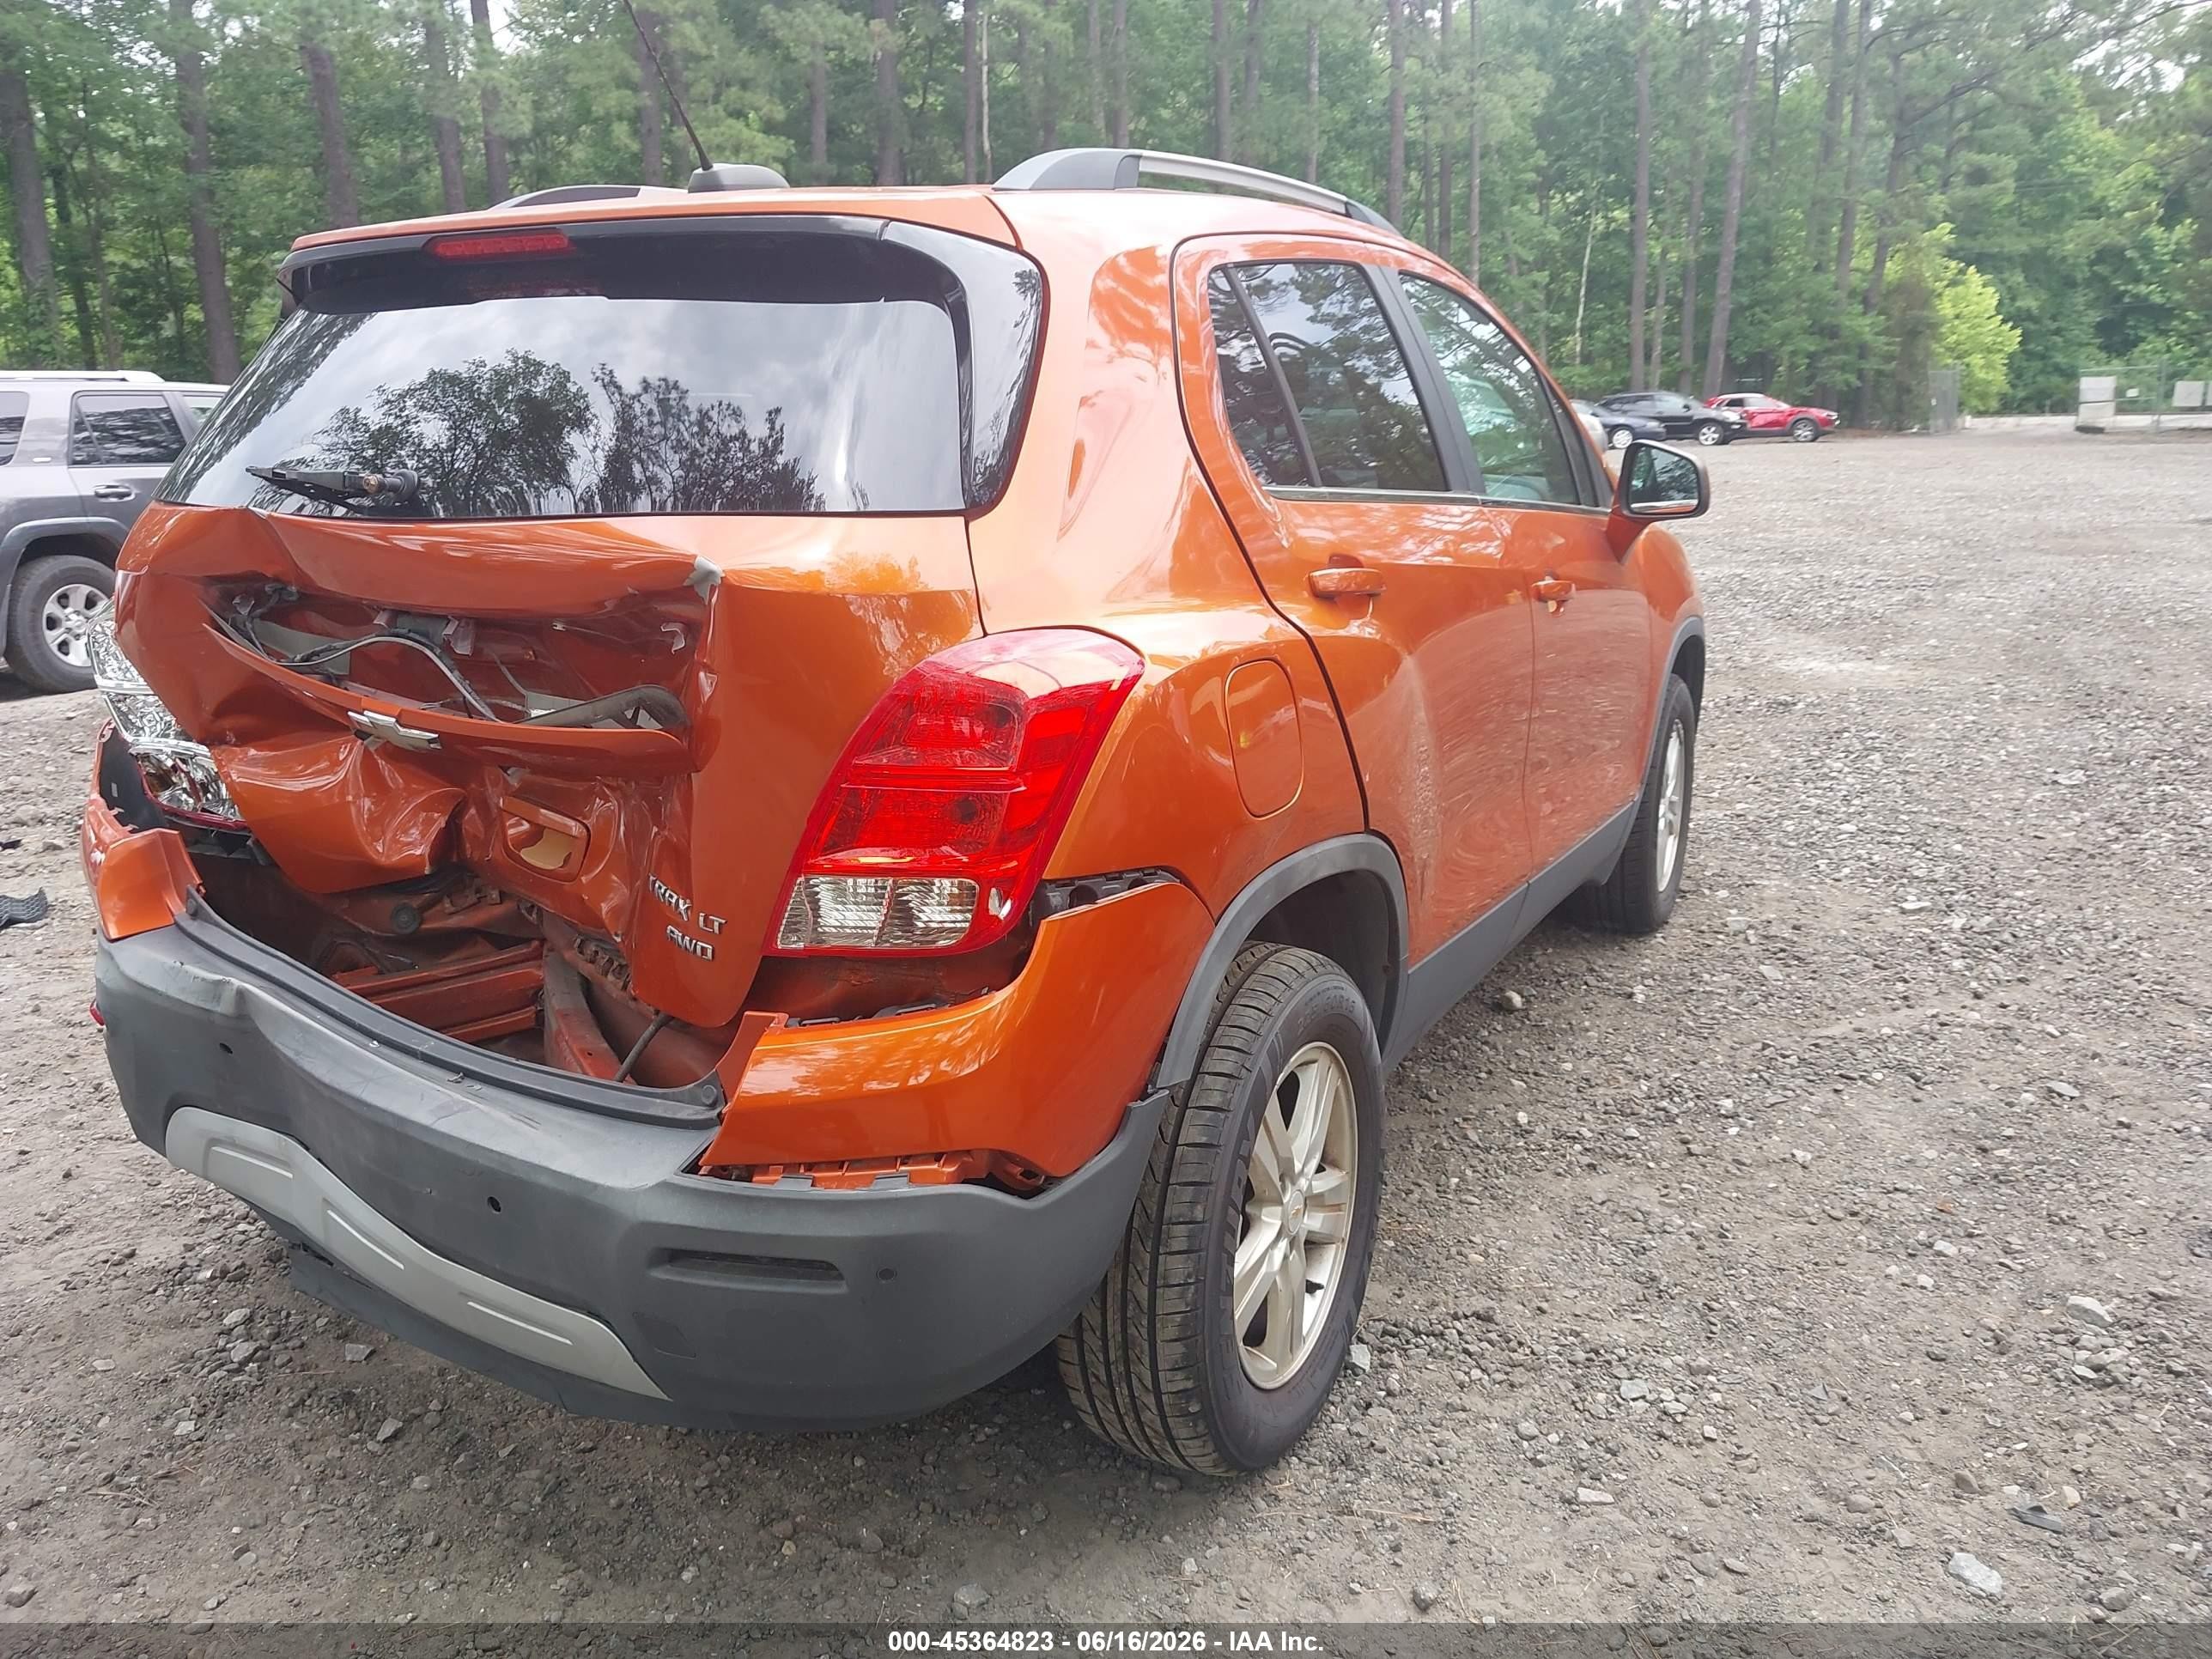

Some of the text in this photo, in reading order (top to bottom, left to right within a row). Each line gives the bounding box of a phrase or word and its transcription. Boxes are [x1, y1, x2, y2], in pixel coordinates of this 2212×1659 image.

[648, 872, 728, 935] TRAX LT
[666, 925, 714, 962] AWD
